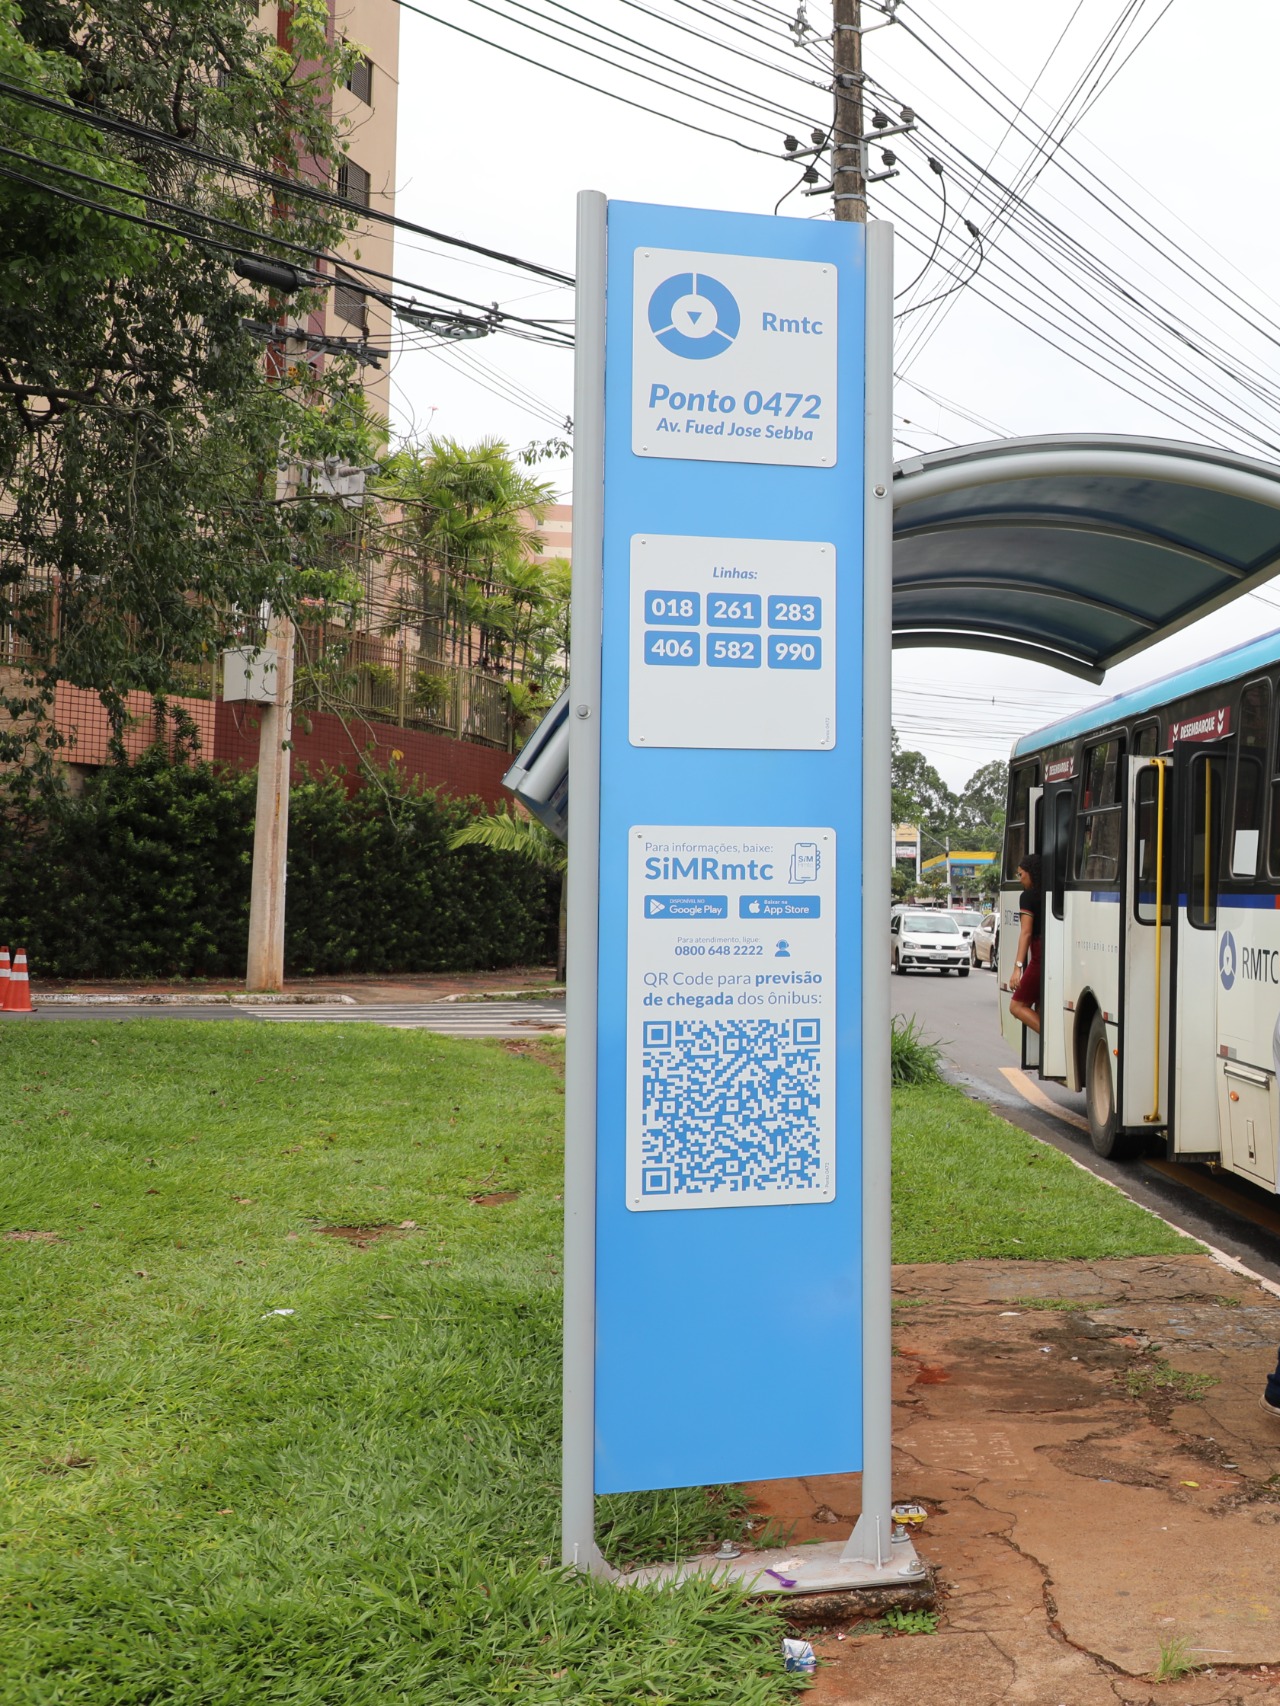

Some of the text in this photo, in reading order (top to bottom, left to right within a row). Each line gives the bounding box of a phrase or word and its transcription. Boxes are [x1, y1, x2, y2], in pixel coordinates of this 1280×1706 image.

[762, 312, 823, 335] Rmtc
[649, 383, 822, 419] Ponto 0472
[656, 417, 814, 441] Av. Fued Jose Sebba
[712, 566, 758, 580] Linhas:
[651, 598, 815, 622] 018 261 283
[651, 639, 815, 661] 406 582 990
[1180, 715, 1215, 739] DESEMBARQUE
[645, 842, 774, 855] Para informações, baixe:
[645, 856, 774, 881] SiMRmtc
[669, 905, 723, 916] Google Play
[764, 905, 810, 916] App Store
[674, 945, 763, 956] 0800 648 2222
[1242, 946, 1279, 984] RMTC
[643, 970, 823, 988] QR Code para previsão
[643, 991, 822, 1009] de chegada dos ônibus:
